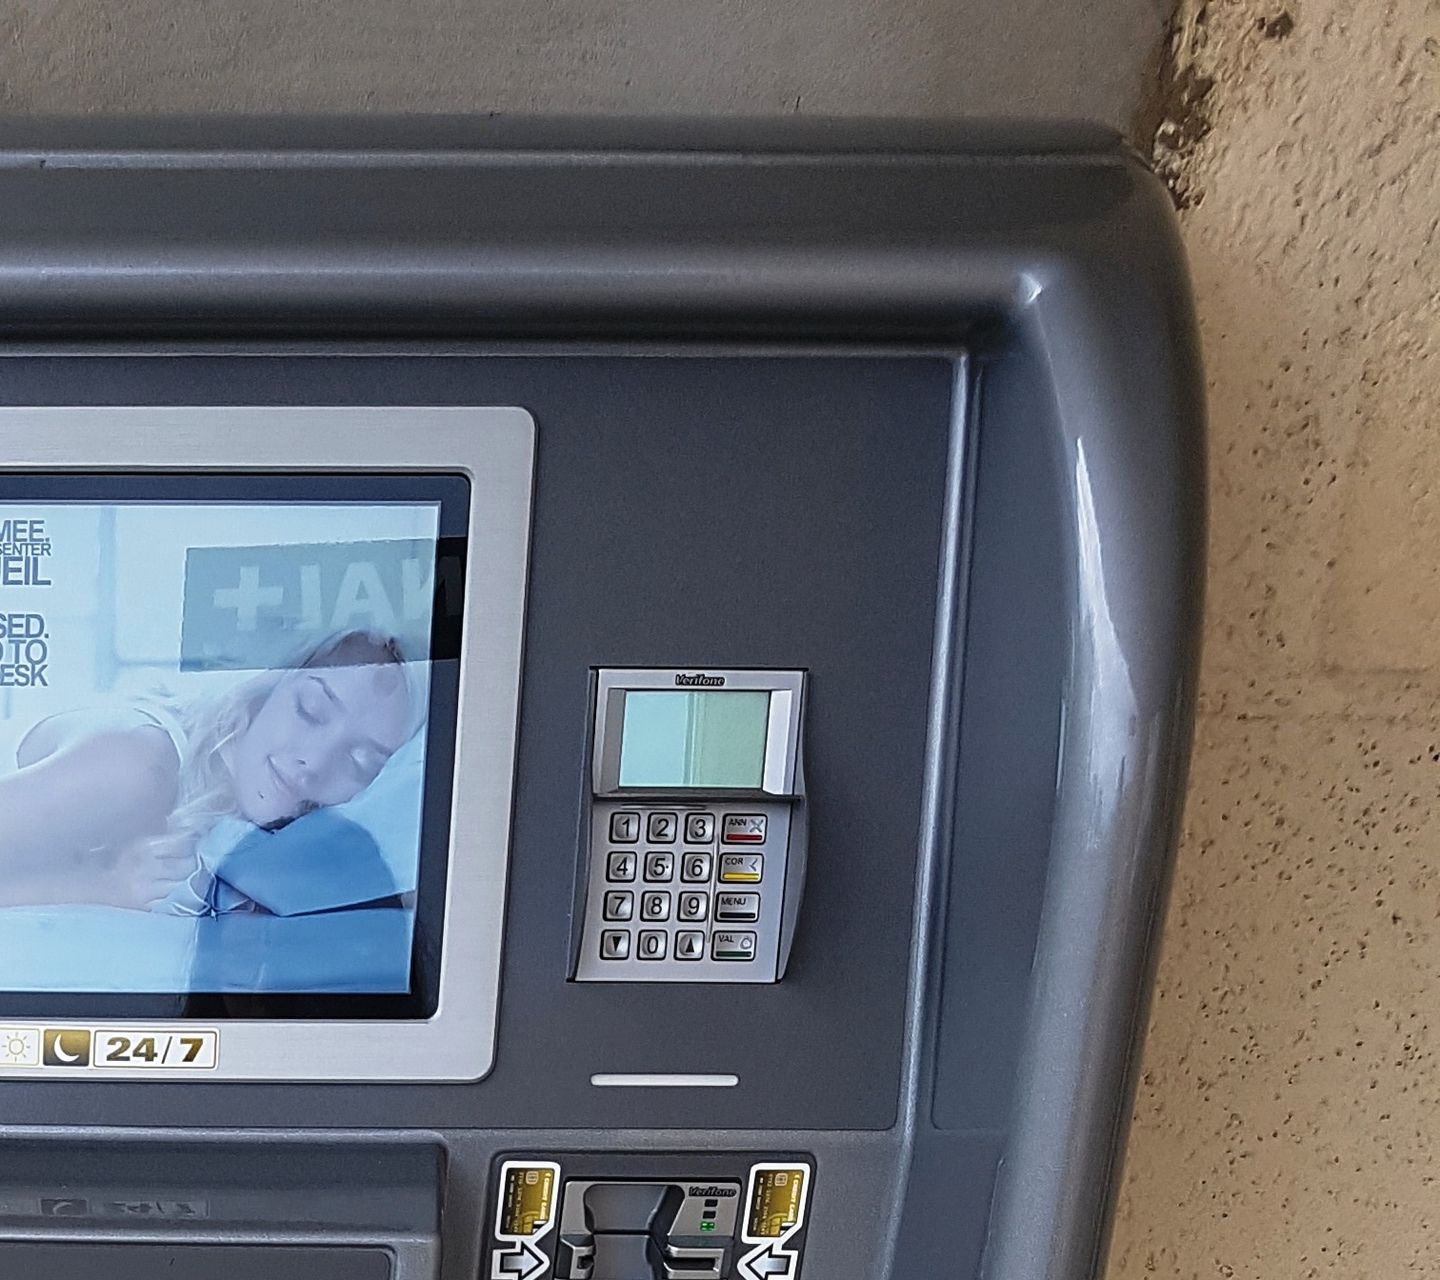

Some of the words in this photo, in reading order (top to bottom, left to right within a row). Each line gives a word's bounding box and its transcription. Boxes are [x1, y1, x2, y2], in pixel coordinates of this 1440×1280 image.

[7, 639, 48, 665] TO
[622, 818, 631, 837] 1
[656, 818, 670, 837] 2
[694, 818, 707, 838] 3
[616, 857, 629, 876] 4
[653, 857, 666, 876] 5
[691, 858, 704, 877] 6
[724, 857, 744, 866] COR
[613, 896, 627, 915] 7
[650, 896, 663, 915] 8
[688, 897, 701, 916] 9
[720, 897, 747, 906] MENU
[647, 935, 659, 954] 0
[718, 935, 735, 944] VAL
[106, 1036, 204, 1064] 24/7
